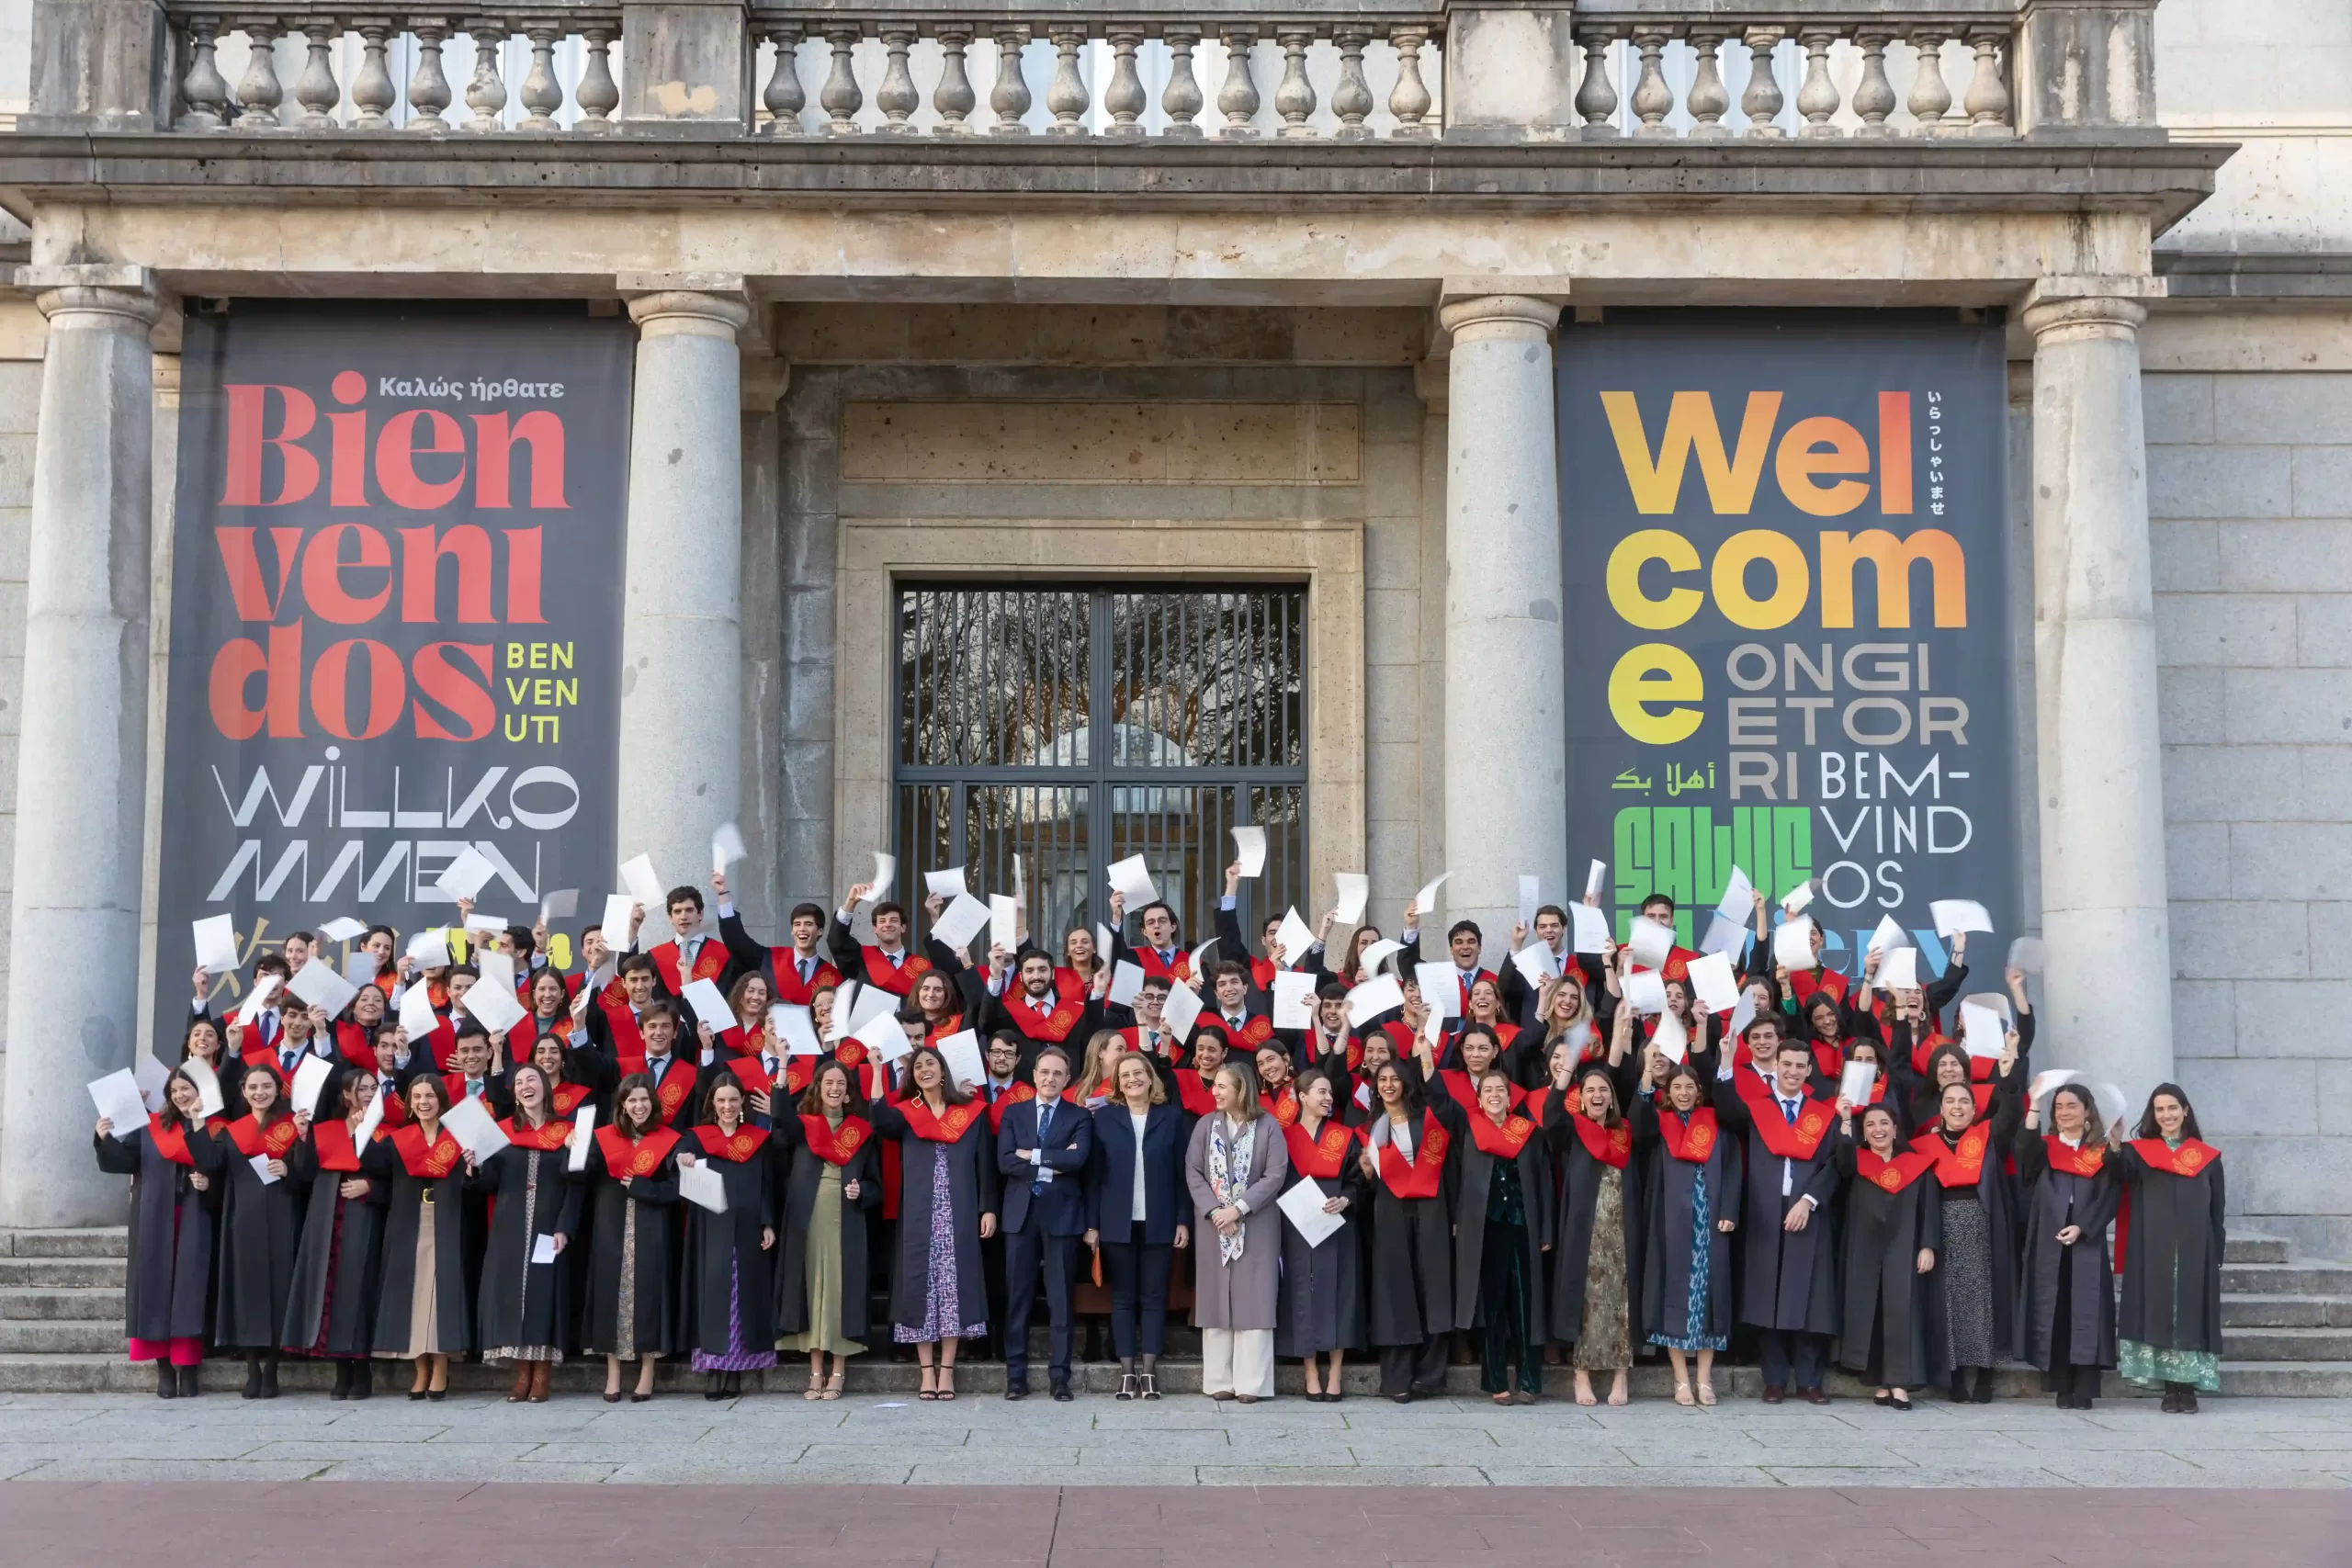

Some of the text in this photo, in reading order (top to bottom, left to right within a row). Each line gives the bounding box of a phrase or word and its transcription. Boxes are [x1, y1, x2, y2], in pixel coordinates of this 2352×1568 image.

[380, 377, 565, 401] Καλώς ήρθατε
[218, 371, 573, 510] Bien
[1600, 391, 1912, 516] Wel
[1928, 391, 1944, 514] いらっしゃいませ
[1606, 529, 1966, 629] com
[209, 616, 496, 741] dos
[507, 641, 573, 671] BEN
[1727, 644, 1928, 691] ONGI
[506, 677, 578, 706] VEN
[1608, 643, 1703, 744] e
[1728, 697, 1969, 745] ETOR
[1667, 762, 1714, 795] أهلا
[1730, 752, 1797, 799] RI
[1821, 752, 1969, 798] BEM-
[1820, 807, 1972, 852] VIND
[1822, 861, 1904, 908] OS
